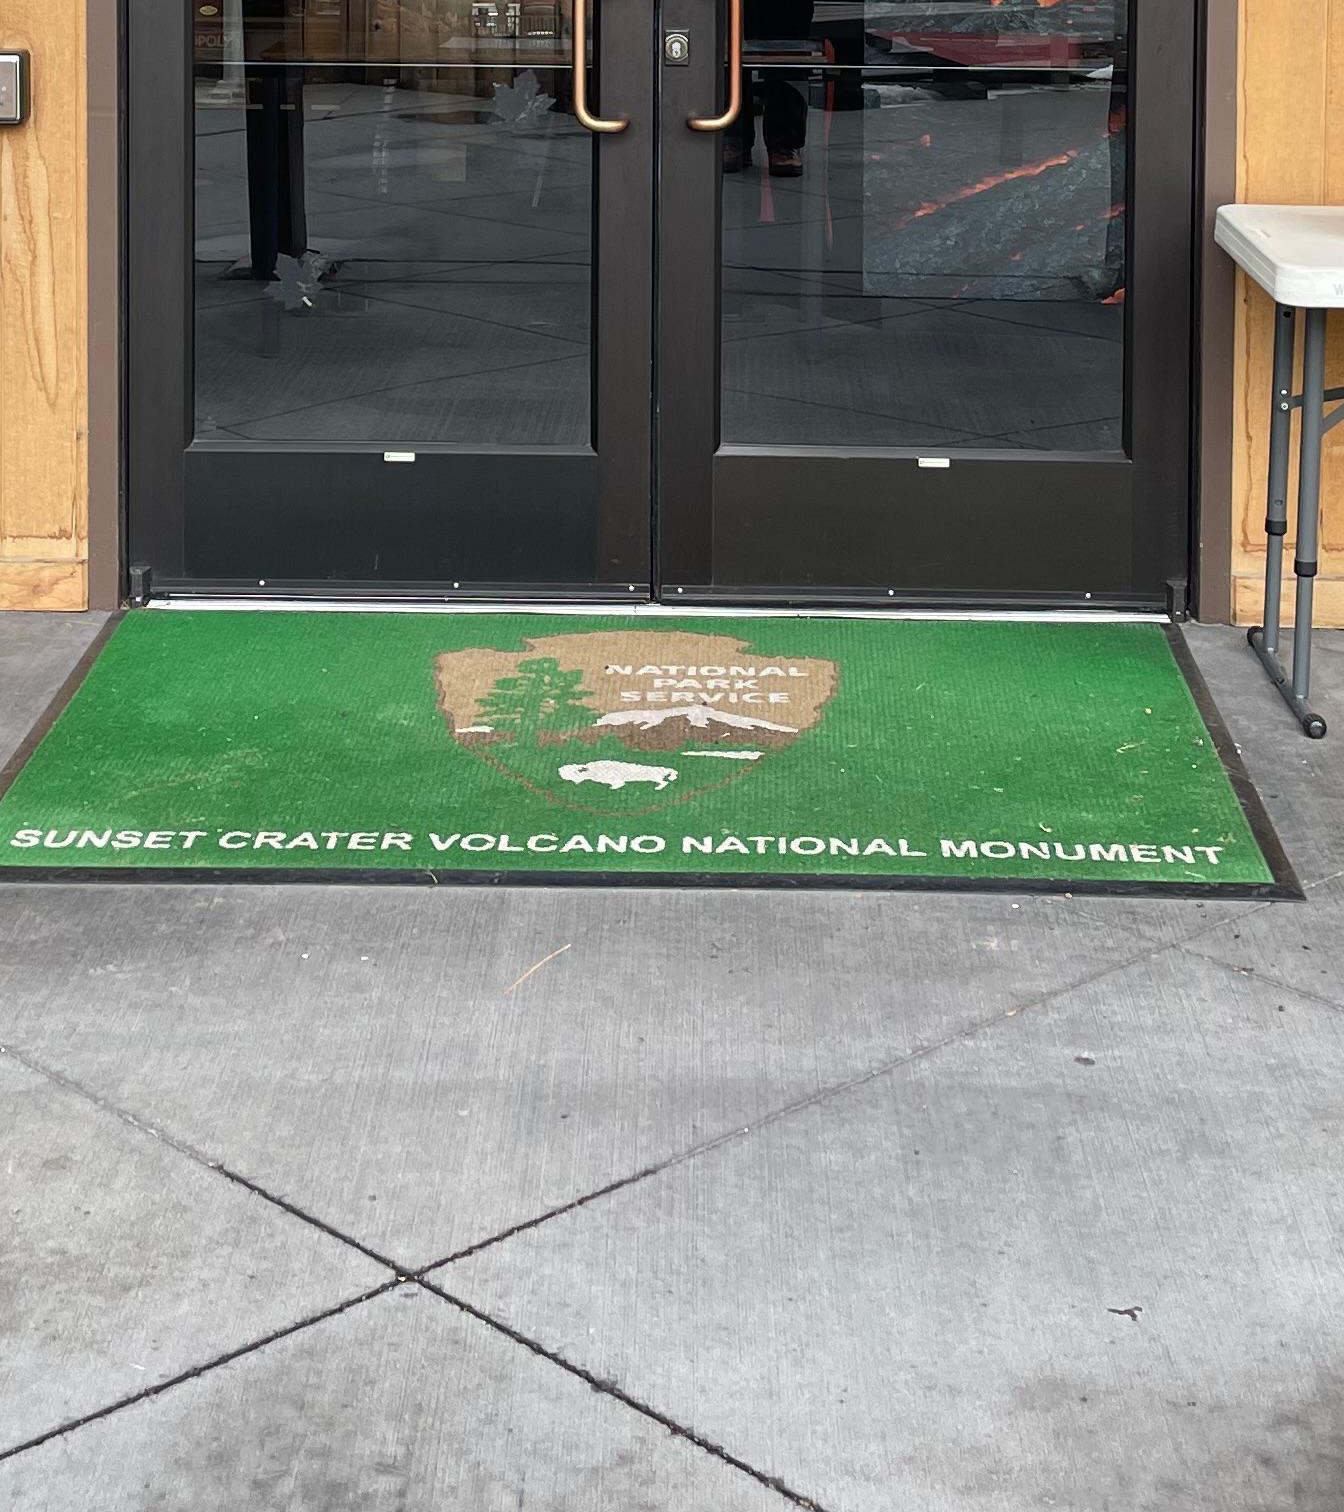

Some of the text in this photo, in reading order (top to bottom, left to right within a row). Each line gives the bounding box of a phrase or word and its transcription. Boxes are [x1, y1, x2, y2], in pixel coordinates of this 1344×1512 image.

[605, 664, 810, 677] NATIONAL
[653, 678, 759, 689] PARK
[620, 691, 791, 704] SERVICE
[9, 828, 1223, 865] SUNSET CRATER VOLCANO NATIONAL MONUMENT
